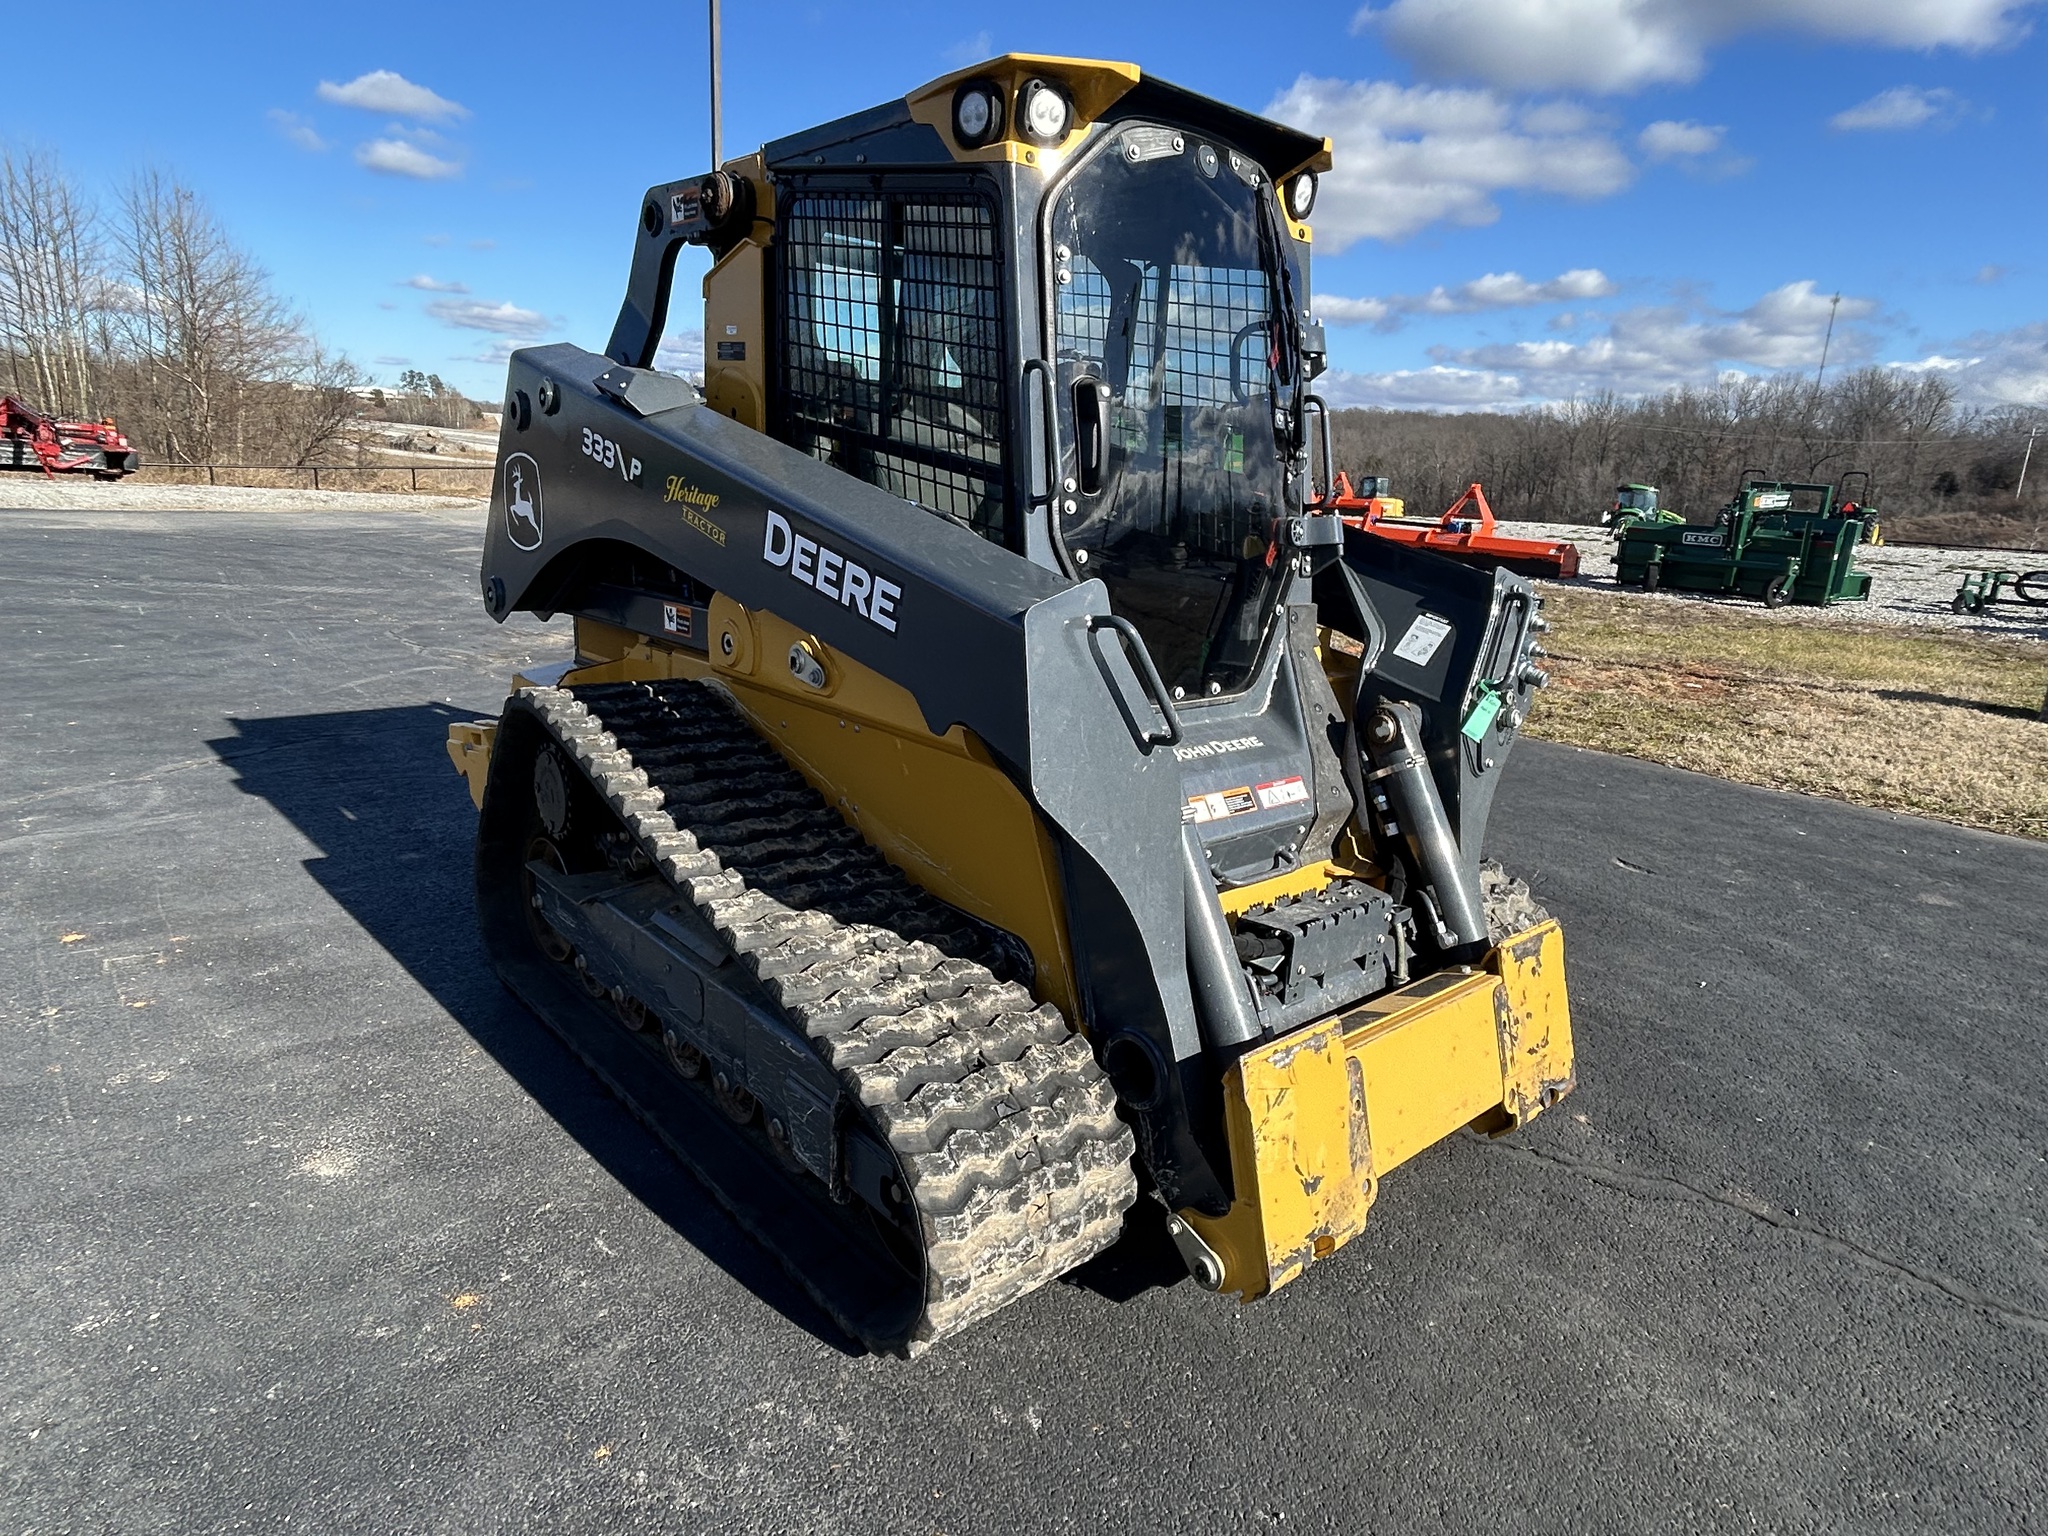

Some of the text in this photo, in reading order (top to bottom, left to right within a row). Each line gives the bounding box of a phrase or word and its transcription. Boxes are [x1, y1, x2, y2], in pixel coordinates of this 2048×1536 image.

[663, 475, 720, 512] Heritage
[681, 507, 726, 544] TRACTOR
[1686, 534, 1720, 544] KMC
[763, 509, 901, 633] DEERE
[1172, 736, 1264, 762] JOHN DEERE
